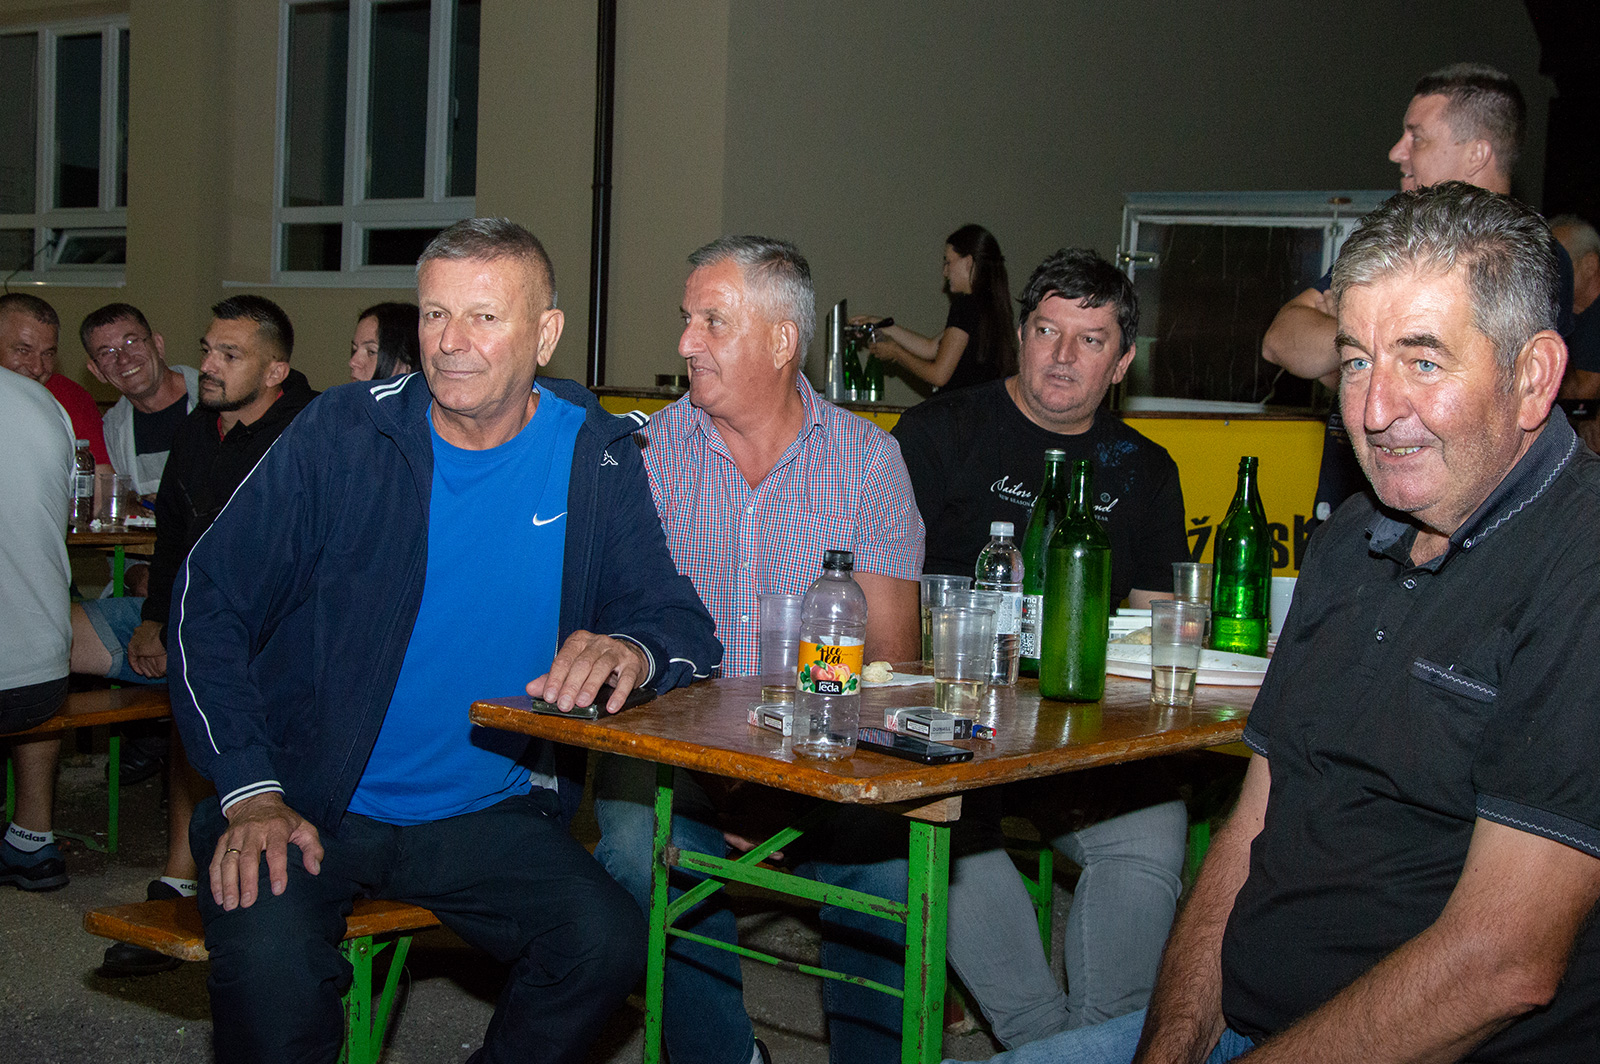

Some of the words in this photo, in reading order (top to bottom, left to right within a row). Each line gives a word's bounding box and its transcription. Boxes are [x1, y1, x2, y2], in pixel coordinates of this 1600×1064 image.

[1010, 497, 1031, 507] SEASON
[820, 648, 843, 665] tea
[825, 646, 842, 656] ice
[818, 682, 840, 693] leda
[10, 827, 47, 842] adidas
